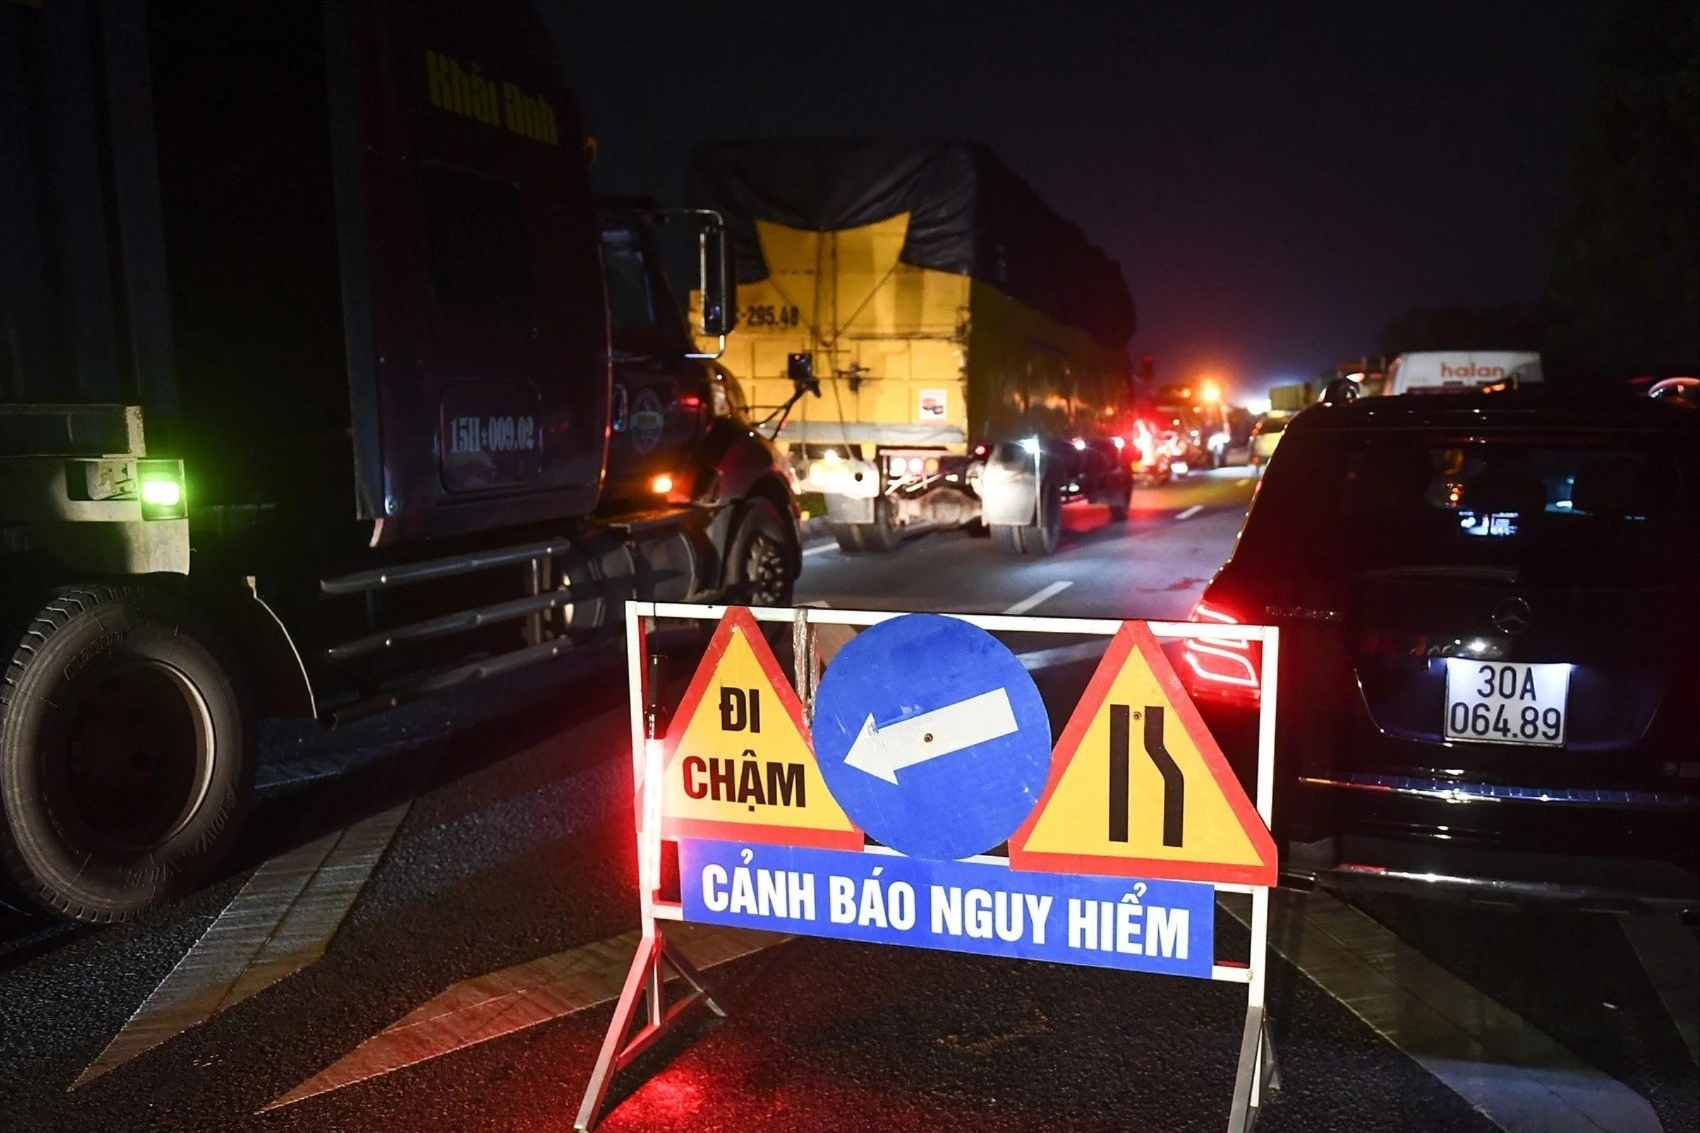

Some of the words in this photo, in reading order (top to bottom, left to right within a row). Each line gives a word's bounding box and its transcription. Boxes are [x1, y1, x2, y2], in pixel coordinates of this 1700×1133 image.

[1441, 362, 1505, 378] halan
[1476, 665, 1537, 701] 30A
[719, 686, 761, 733] ĐI
[1450, 702, 1562, 741] 064.89
[682, 749, 807, 812] CHẬM
[701, 848, 816, 921] CẢNH
[829, 866, 917, 931] BÁO
[930, 885, 1054, 945] NGUY
[1068, 882, 1190, 960] HIỂM
